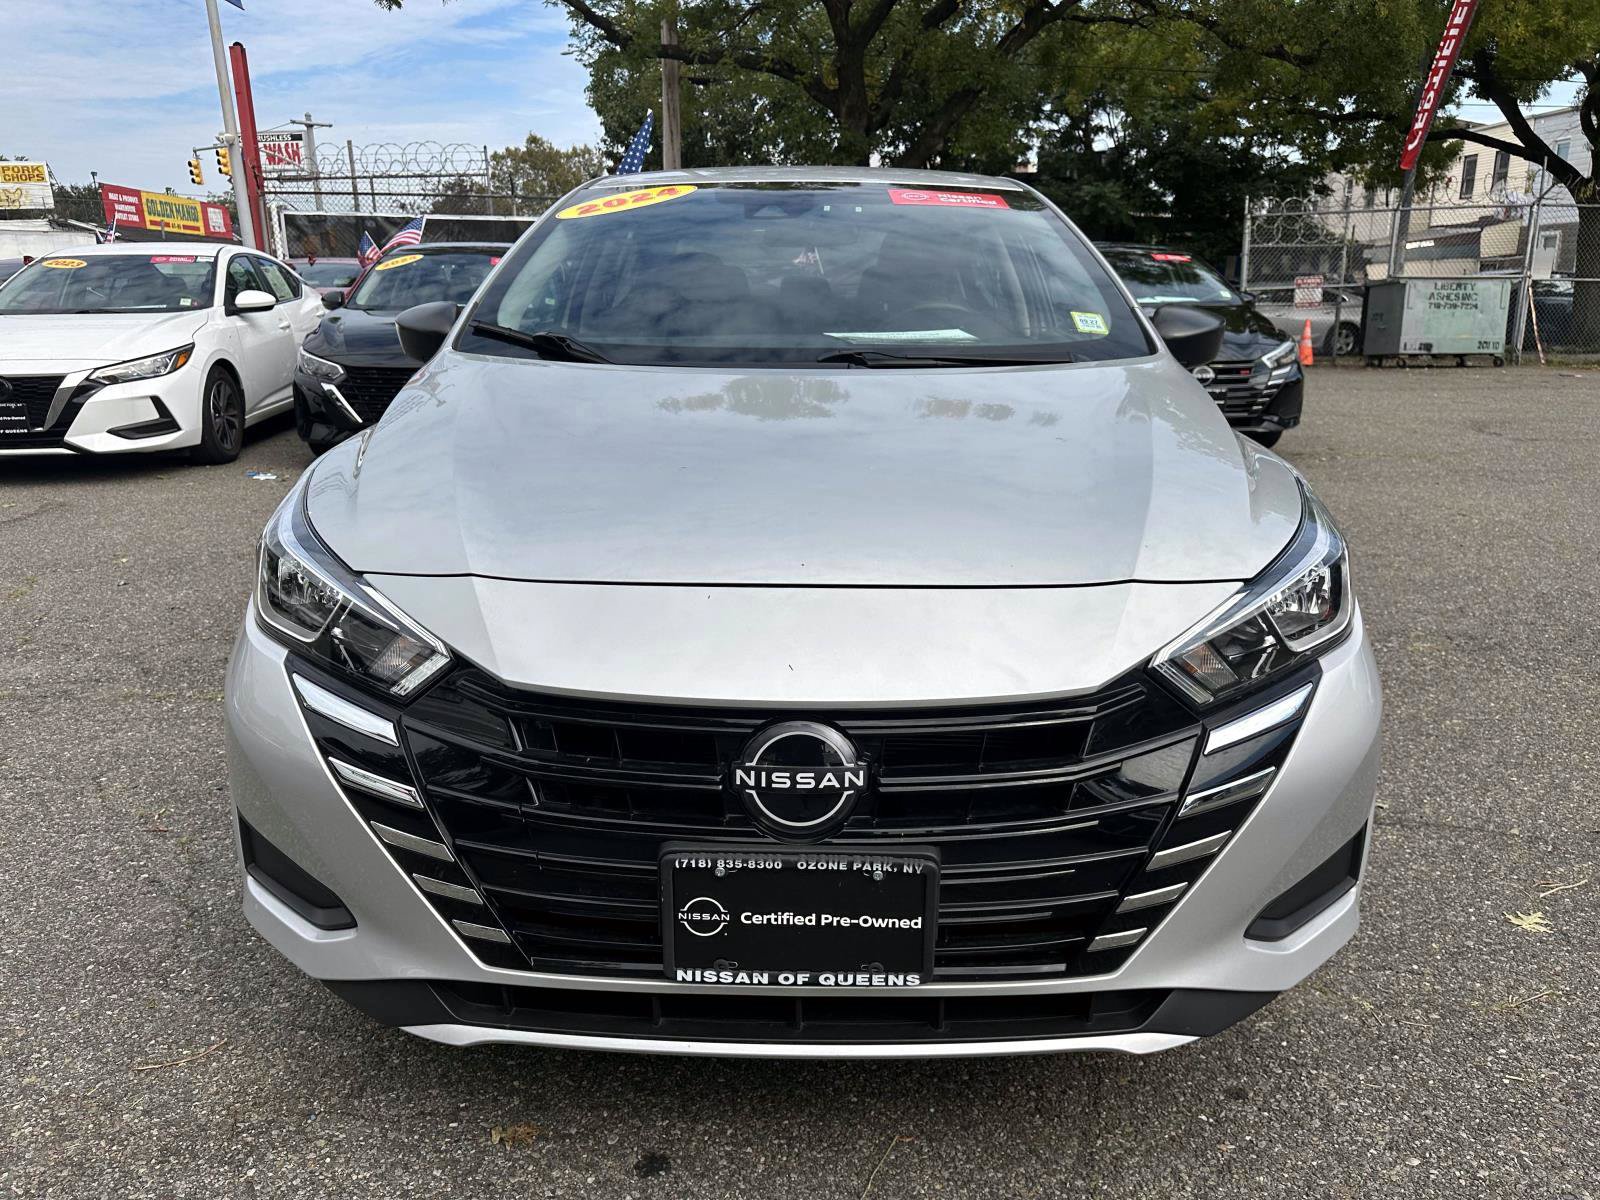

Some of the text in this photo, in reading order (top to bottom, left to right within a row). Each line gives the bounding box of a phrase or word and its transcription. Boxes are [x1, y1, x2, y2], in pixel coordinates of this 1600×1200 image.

[263, 143, 301, 165] WASH
[1, 165, 43, 174] PORK
[3, 173, 45, 182] CHOPS
[576, 187, 678, 216] 2024
[146, 199, 175, 217] GOLDEN
[174, 204, 200, 223] MANGO
[1434, 282, 1477, 291] LIBERTY
[735, 769, 865, 789] NISSAN
[675, 859, 712, 868] (718)
[716, 859, 783, 870] 835-8300
[797, 861, 848, 871] OZONE
[852, 862, 897, 873] PARK,
[678, 911, 730, 922] NISSAN
[740, 912, 922, 929] Certified Pre-Owned
[676, 969, 921, 987] NISSAN OF QUEENS
